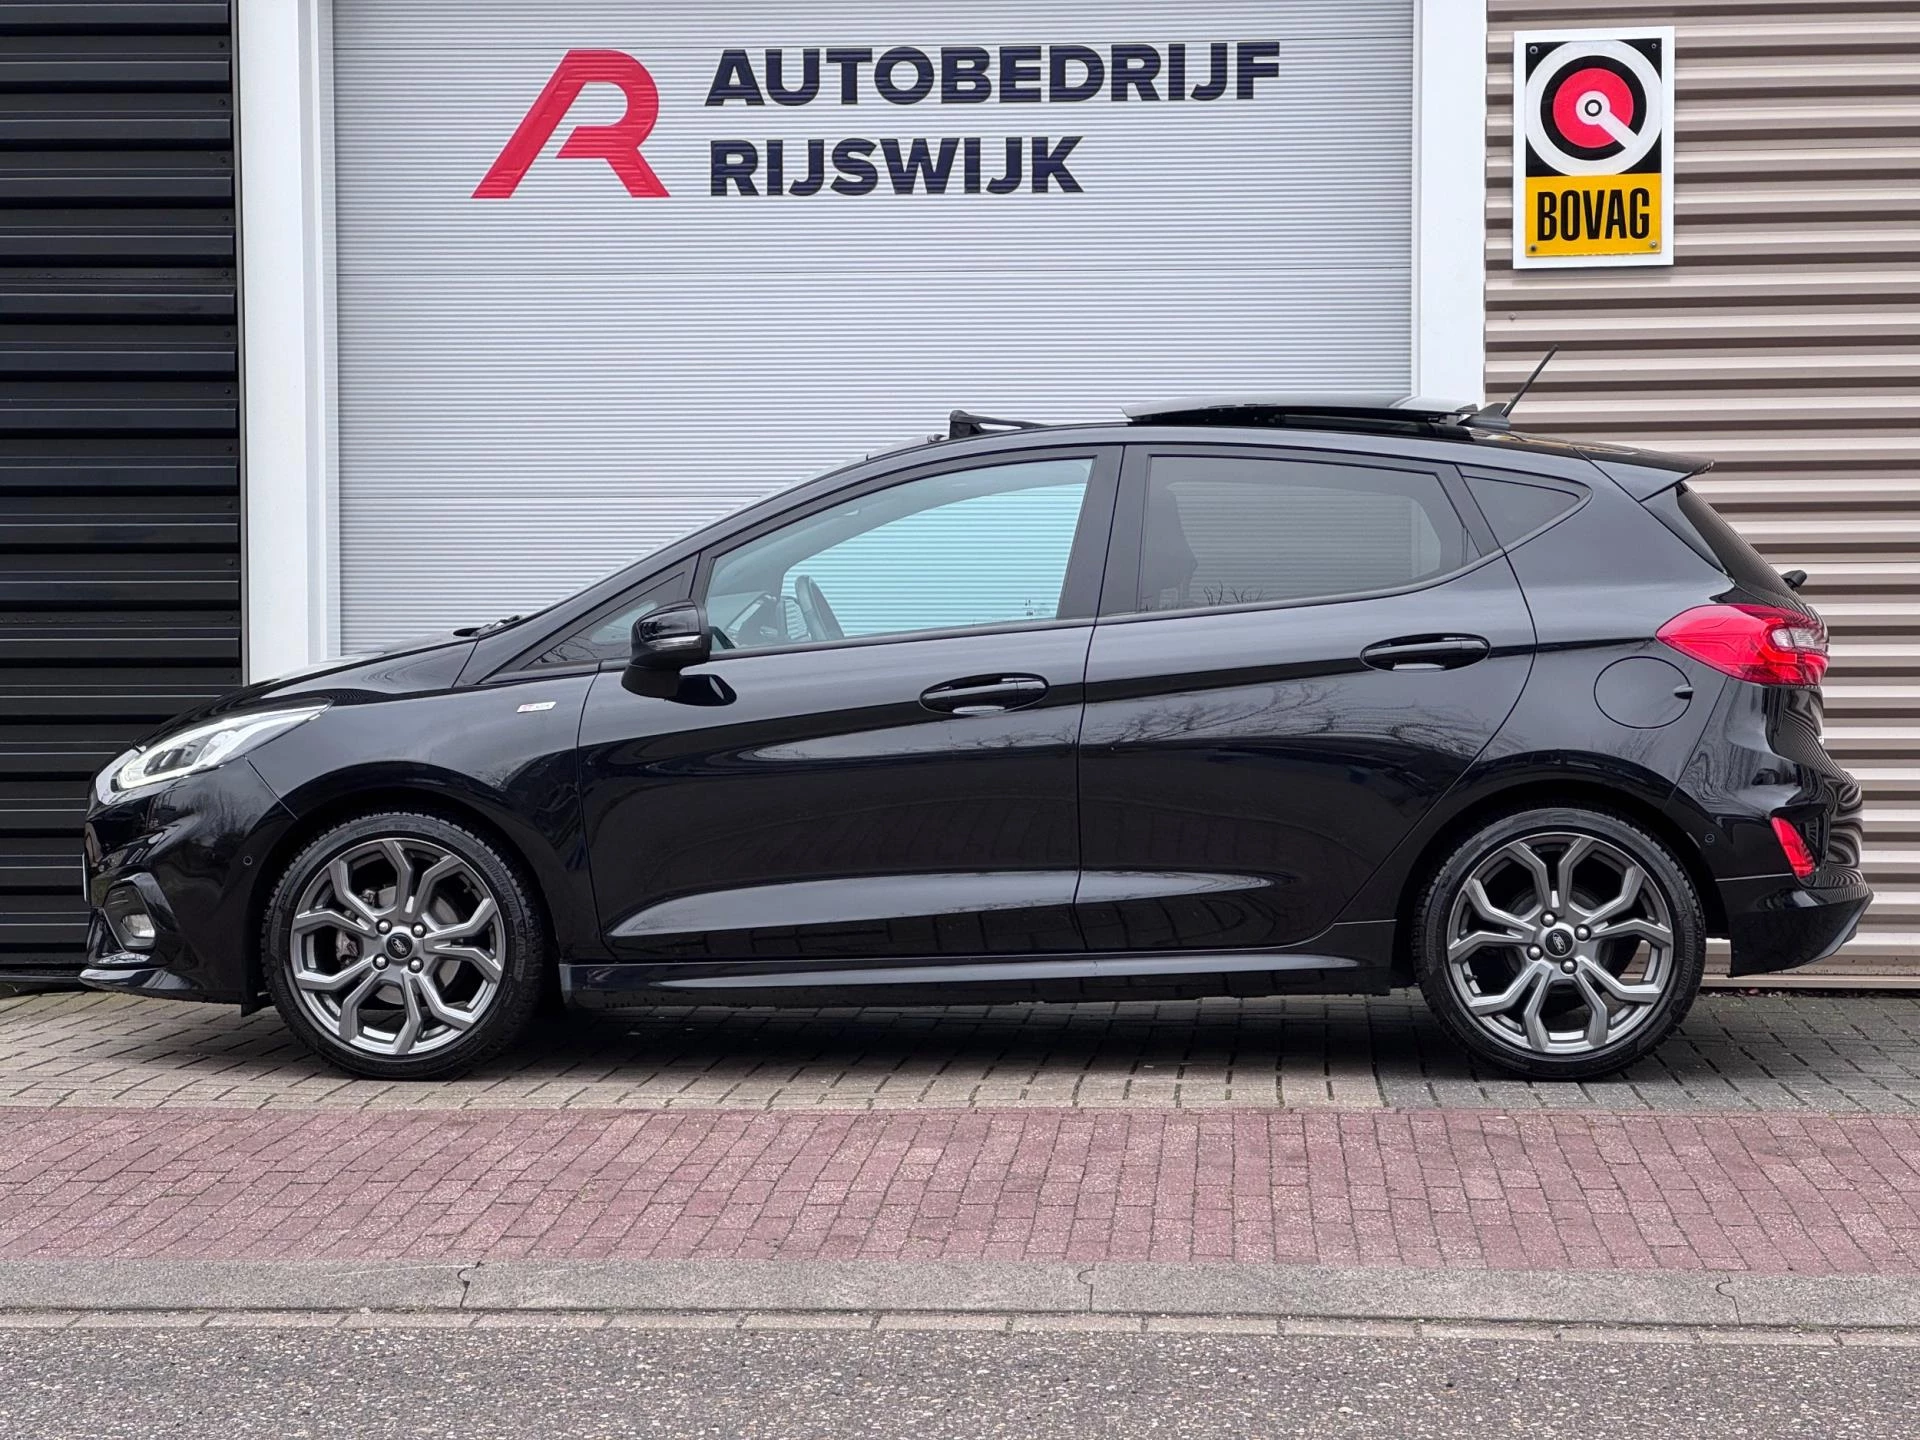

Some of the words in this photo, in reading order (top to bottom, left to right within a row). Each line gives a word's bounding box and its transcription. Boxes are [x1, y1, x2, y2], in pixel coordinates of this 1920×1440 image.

[705, 41, 1280, 107] AUTOBEDRIJF
[710, 136, 1084, 197] RIJSWIJK
[1537, 187, 1650, 242] BOVAG
